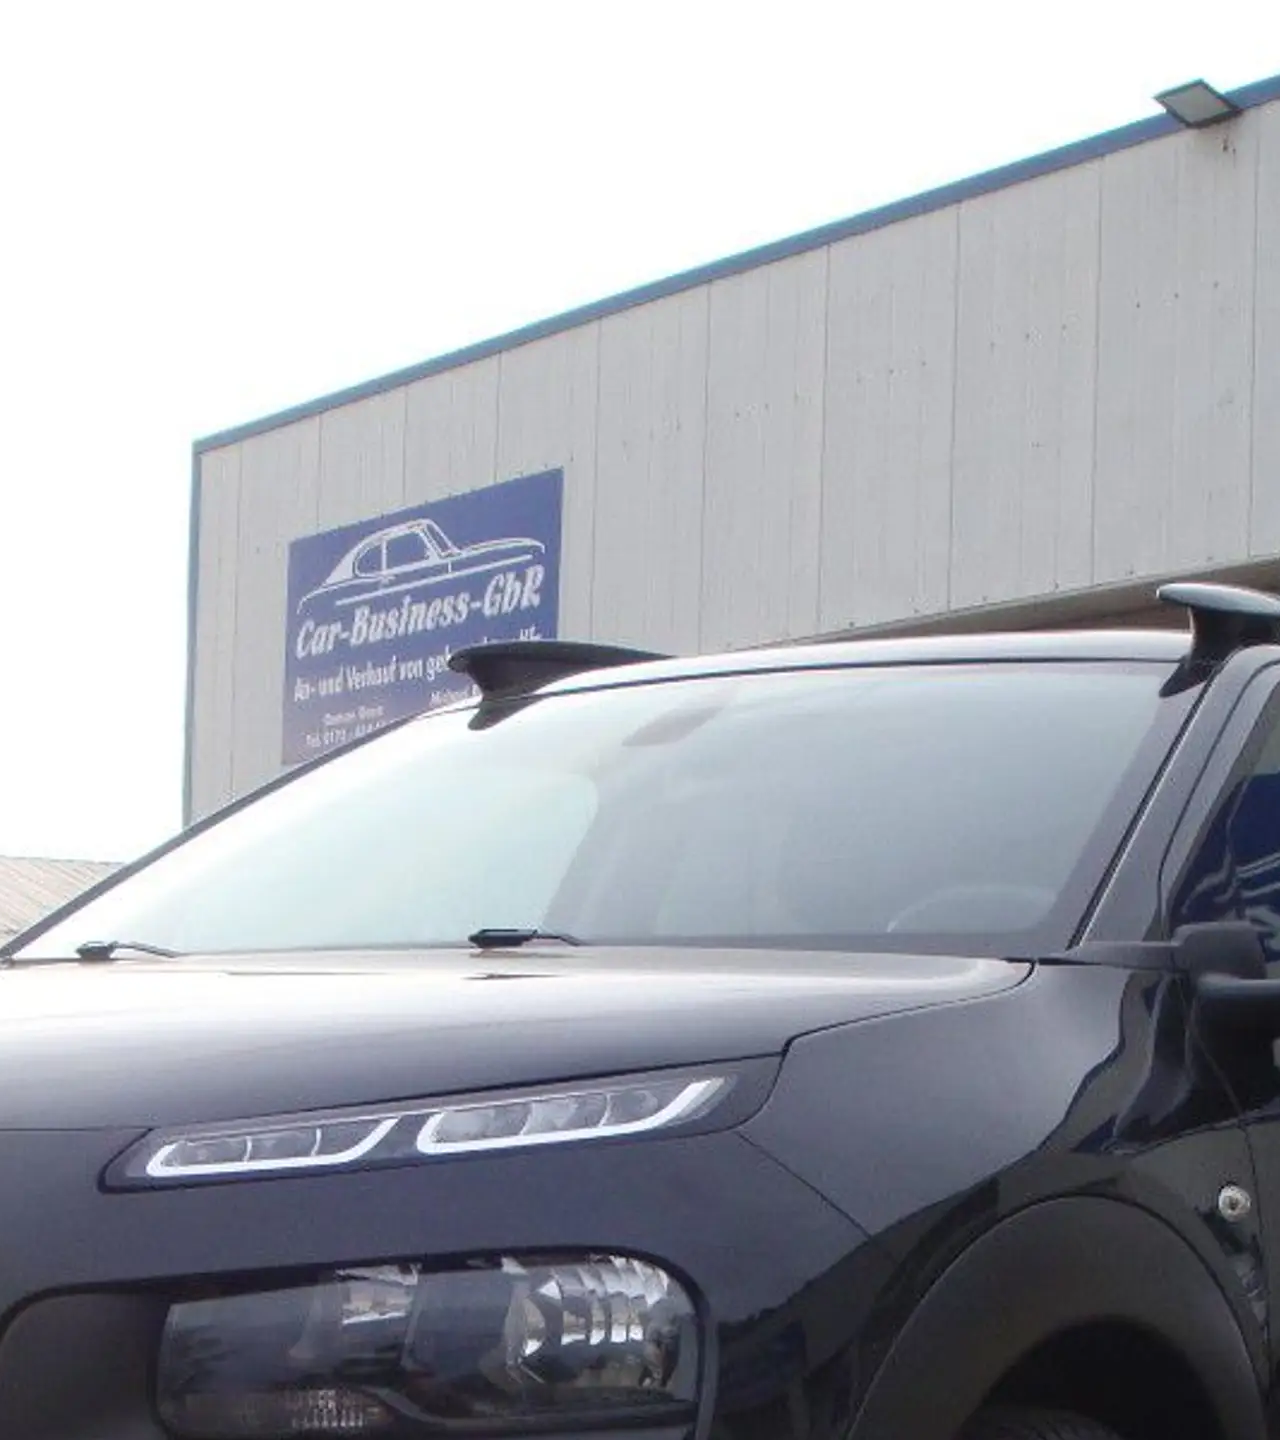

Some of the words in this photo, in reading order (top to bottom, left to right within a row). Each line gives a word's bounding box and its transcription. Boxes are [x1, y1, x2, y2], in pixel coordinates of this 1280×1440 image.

[296, 565, 546, 660] Car-Business-GbR
[319, 664, 346, 695] und
[346, 655, 397, 693] Verkauf
[399, 656, 424, 682] von
